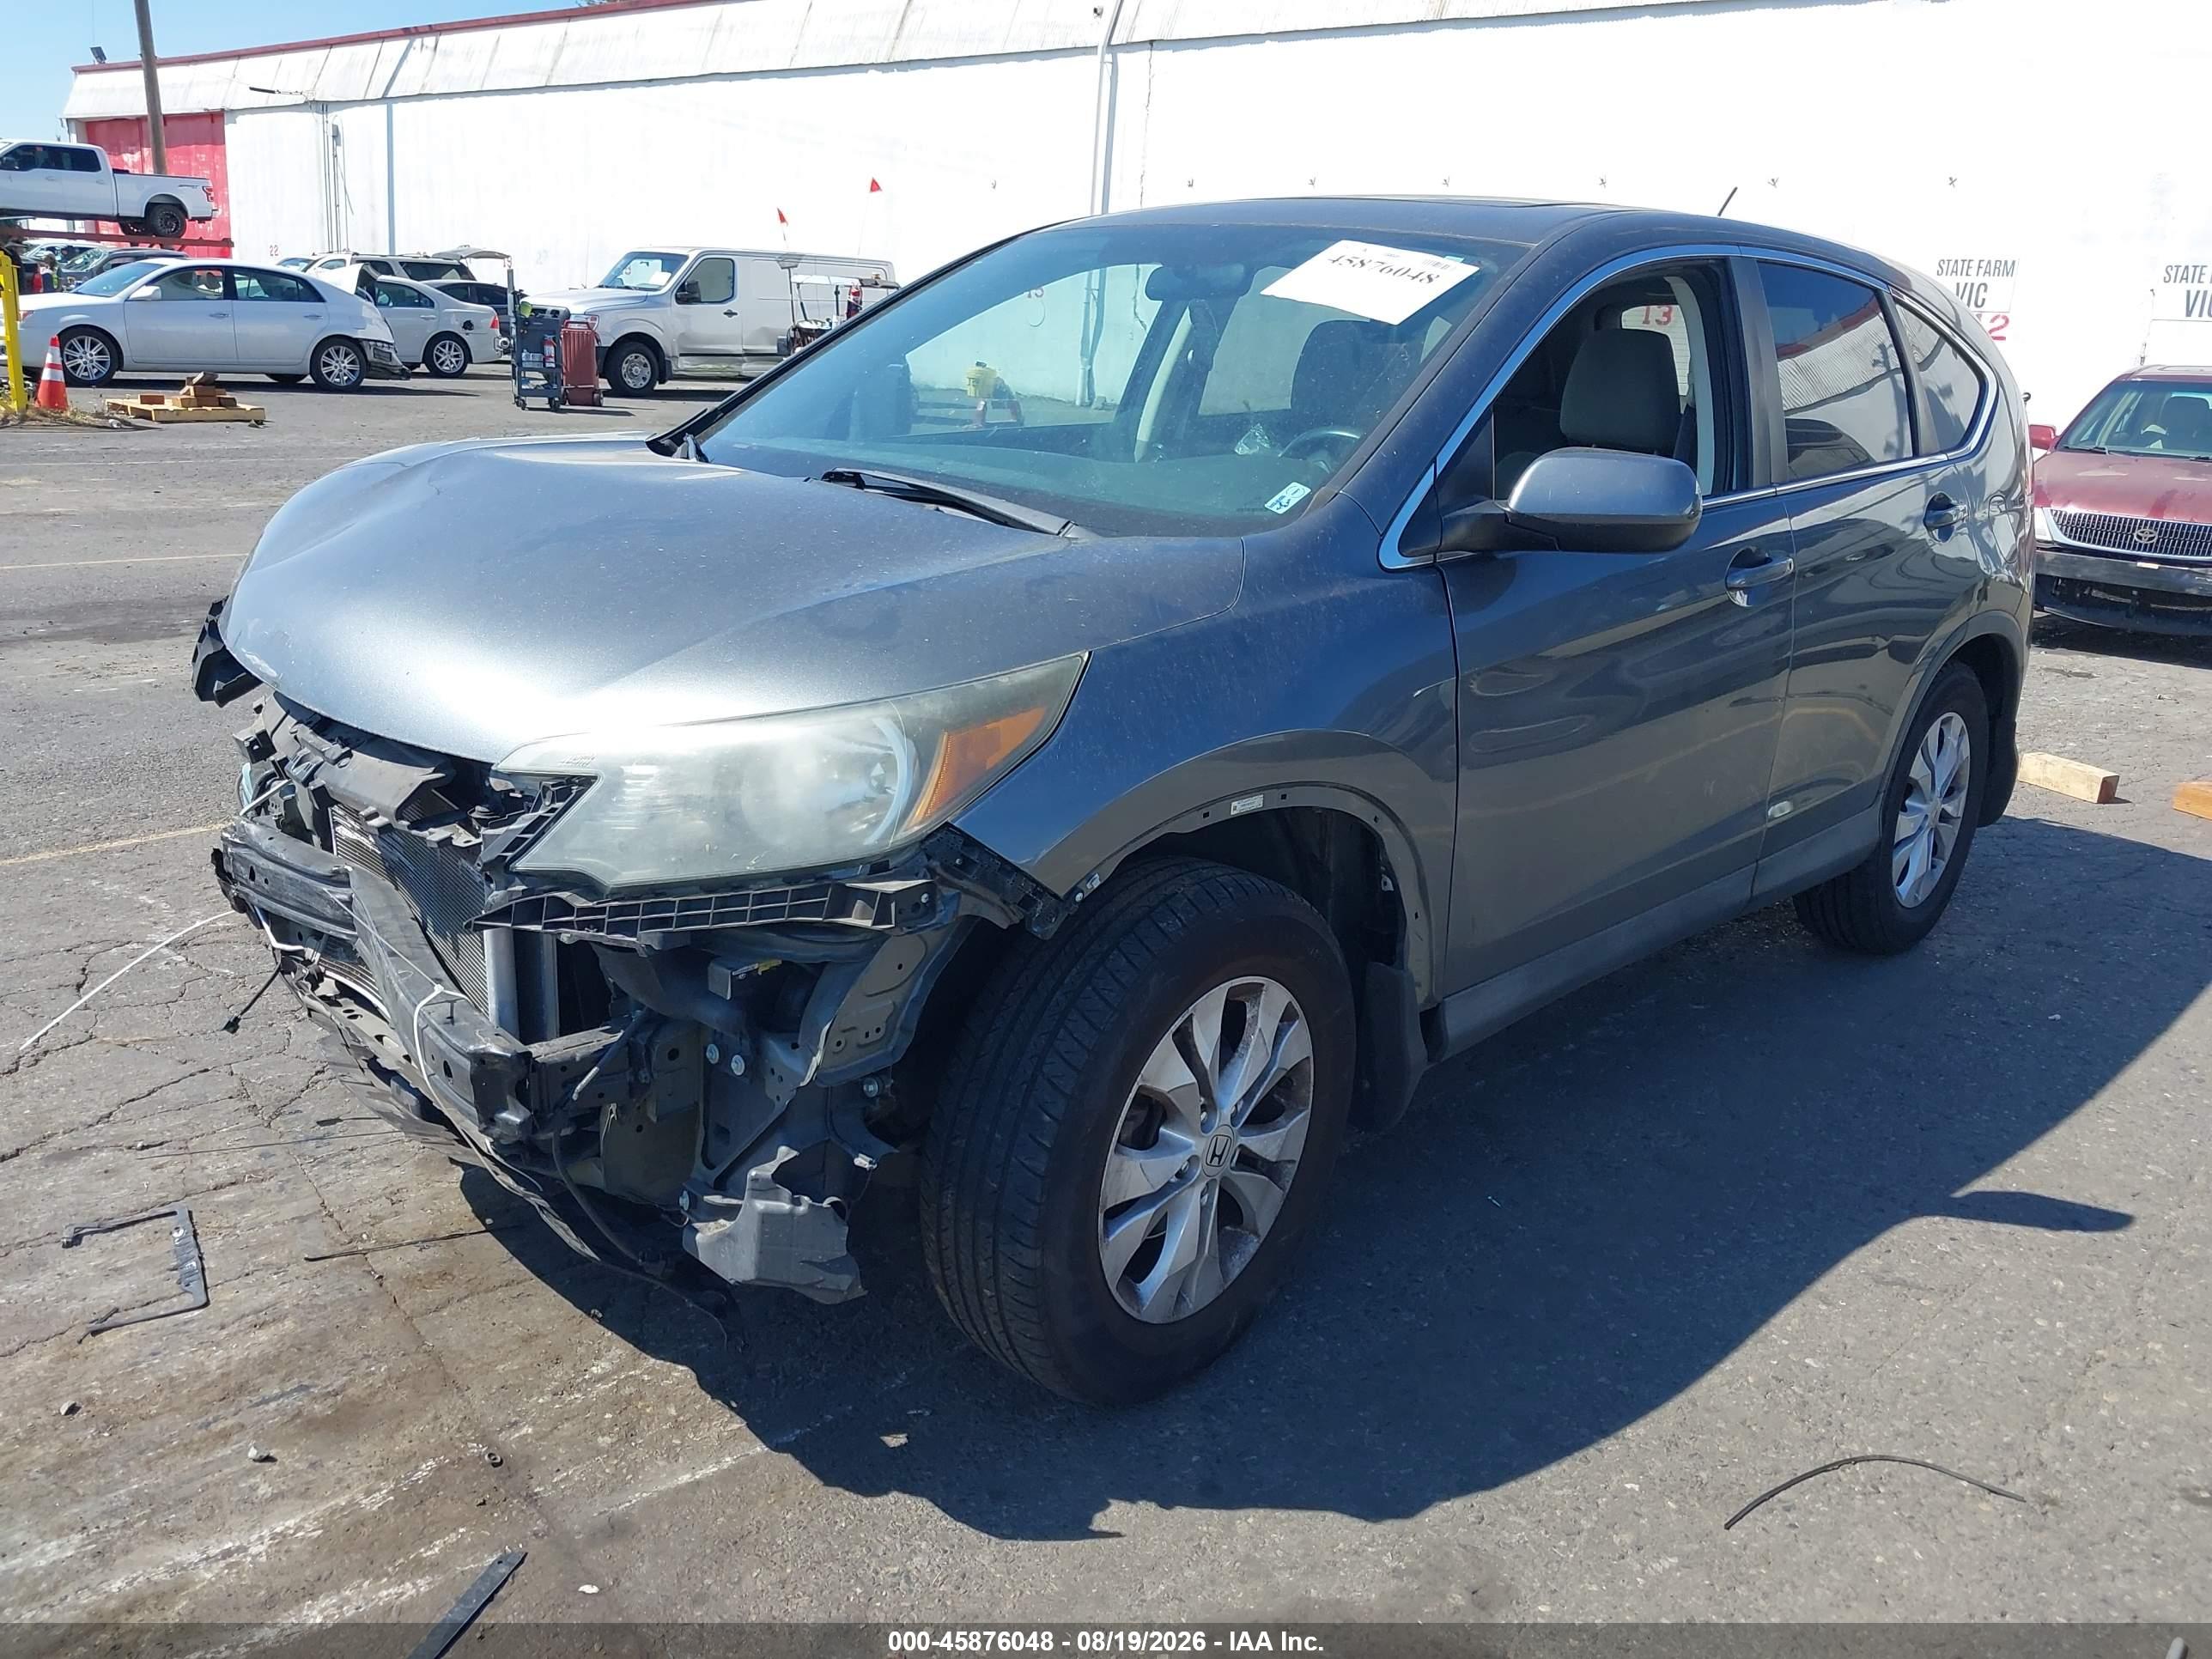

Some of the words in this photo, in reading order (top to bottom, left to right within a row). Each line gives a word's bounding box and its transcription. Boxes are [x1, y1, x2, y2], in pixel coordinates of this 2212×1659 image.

[1328, 254, 1441, 284] 45876048
[1936, 258, 1974, 276] STATE
[1976, 259, 2016, 277] FARM
[2163, 264, 2209, 283] STATE
[1641, 306, 1674, 325] 13
